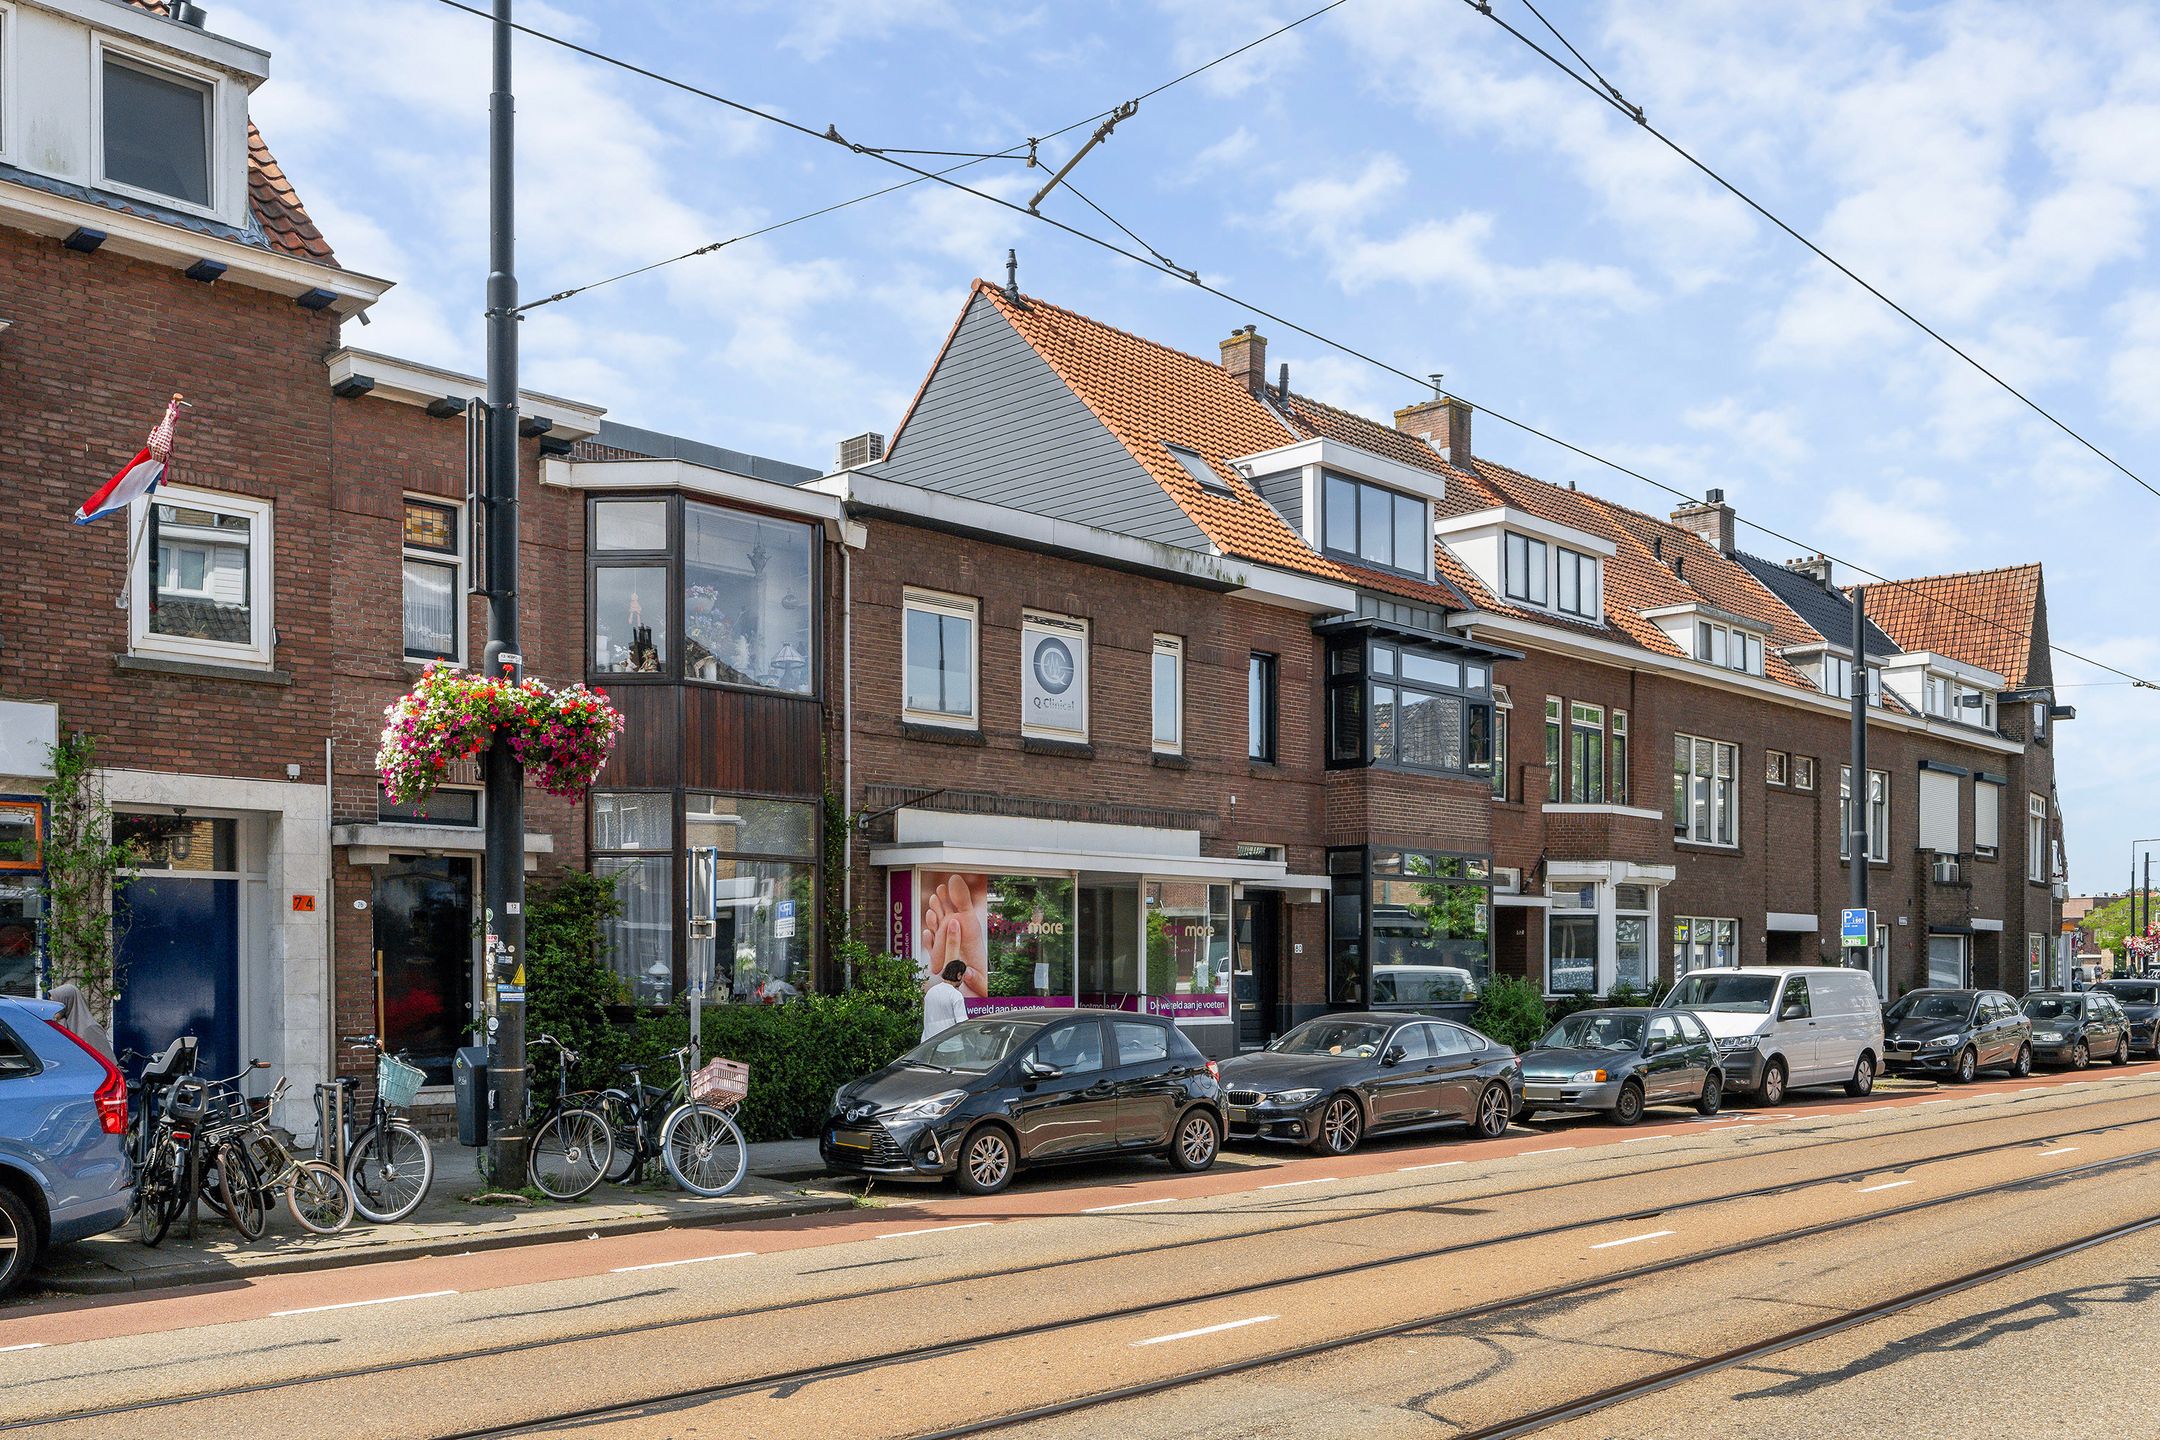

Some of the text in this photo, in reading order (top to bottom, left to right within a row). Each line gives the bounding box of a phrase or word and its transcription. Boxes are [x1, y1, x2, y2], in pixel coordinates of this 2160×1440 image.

[1033, 697, 1041, 709] Q
[294, 897, 313, 909] 74
[1844, 911, 1852, 923] P
[967, 1005, 994, 1014] wereld
[1196, 1001, 1202, 1010] je
[1203, 1001, 1225, 1009] voeten
